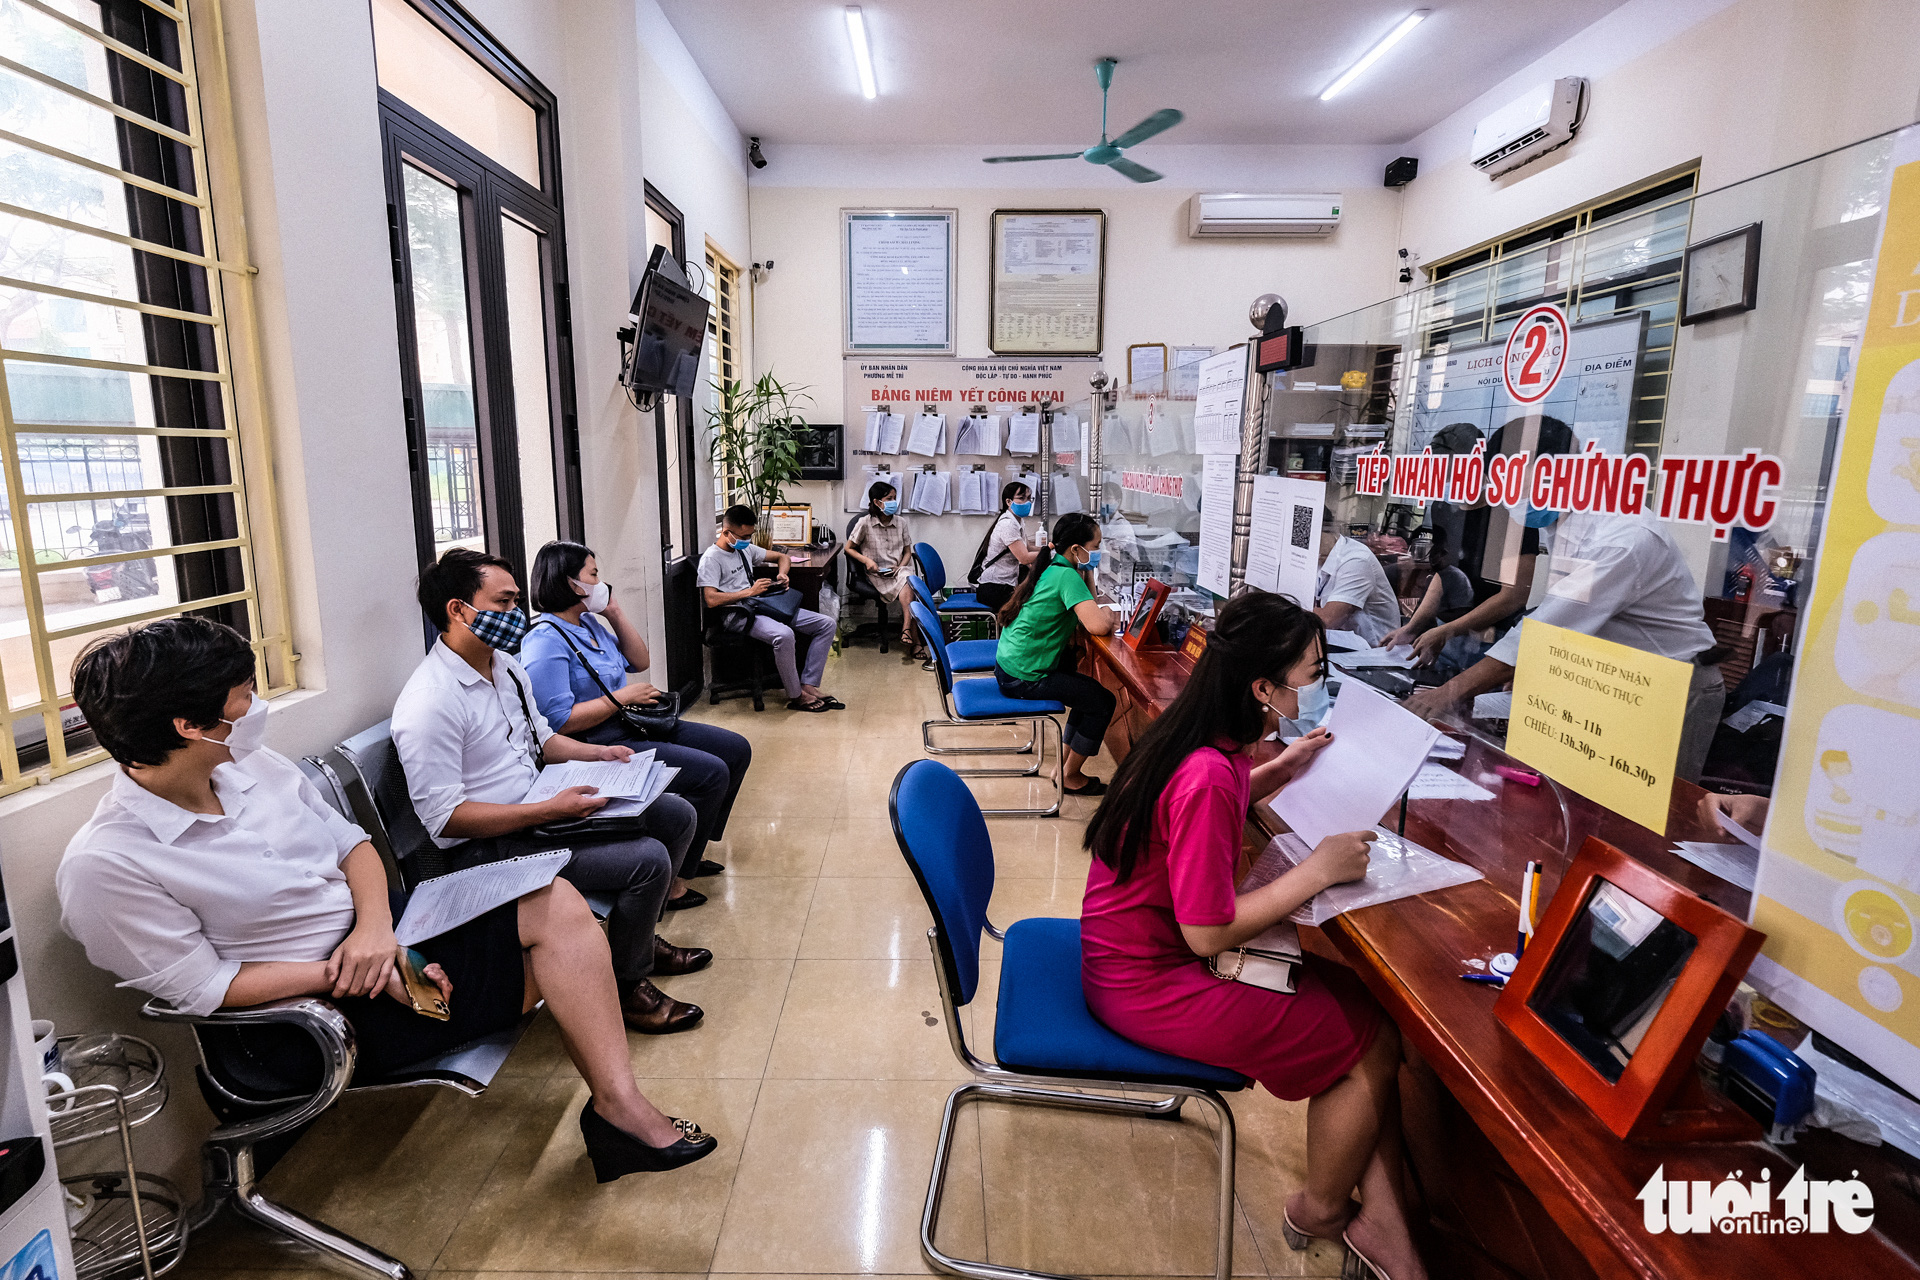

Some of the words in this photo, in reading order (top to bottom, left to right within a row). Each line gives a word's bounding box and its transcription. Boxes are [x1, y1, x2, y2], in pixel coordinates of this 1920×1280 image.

[881, 363, 896, 371] NHÂN
[897, 363, 908, 371] DÂN
[1467, 357, 1493, 371] LỊCH
[1496, 351, 1529, 366] CNG
[1519, 325, 1547, 385] 2
[1585, 363, 1602, 372] ĐỊA
[1605, 357, 1632, 370] ĐIỂM
[871, 384, 911, 402] BẢNG
[915, 387, 953, 402] NIÊM
[959, 386, 985, 402] YẾT
[988, 387, 1027, 403] CÔNG
[1478, 375, 1491, 386] NỘI
[1492, 375, 1514, 384] DUG
[1356, 442, 1390, 495] TIẾP
[1392, 447, 1448, 507] NHẬN
[1450, 439, 1486, 502] HỒ
[1487, 452, 1529, 505] SƠ
[1533, 440, 1648, 516] CHỨNG
[1660, 452, 1781, 540] THỰC
[1549, 645, 1569, 662] THỜI
[1570, 653, 1593, 670] GIAN
[1595, 659, 1617, 677] TIẾP
[1619, 669, 1651, 687] NHẬN
[1549, 664, 1562, 677] HỒ
[1563, 669, 1575, 682] SƠ
[1575, 673, 1610, 696] CHỨNG
[1613, 687, 1643, 707] THỰC
[1527, 694, 1557, 717] SÁNG:
[1562, 709, 1573, 725] 8h
[1584, 719, 1602, 737] 11h
[1524, 715, 1557, 740] CHIỀU:
[1559, 731, 1596, 761] 13h.30p
[1609, 754, 1656, 787] 16h.30p
